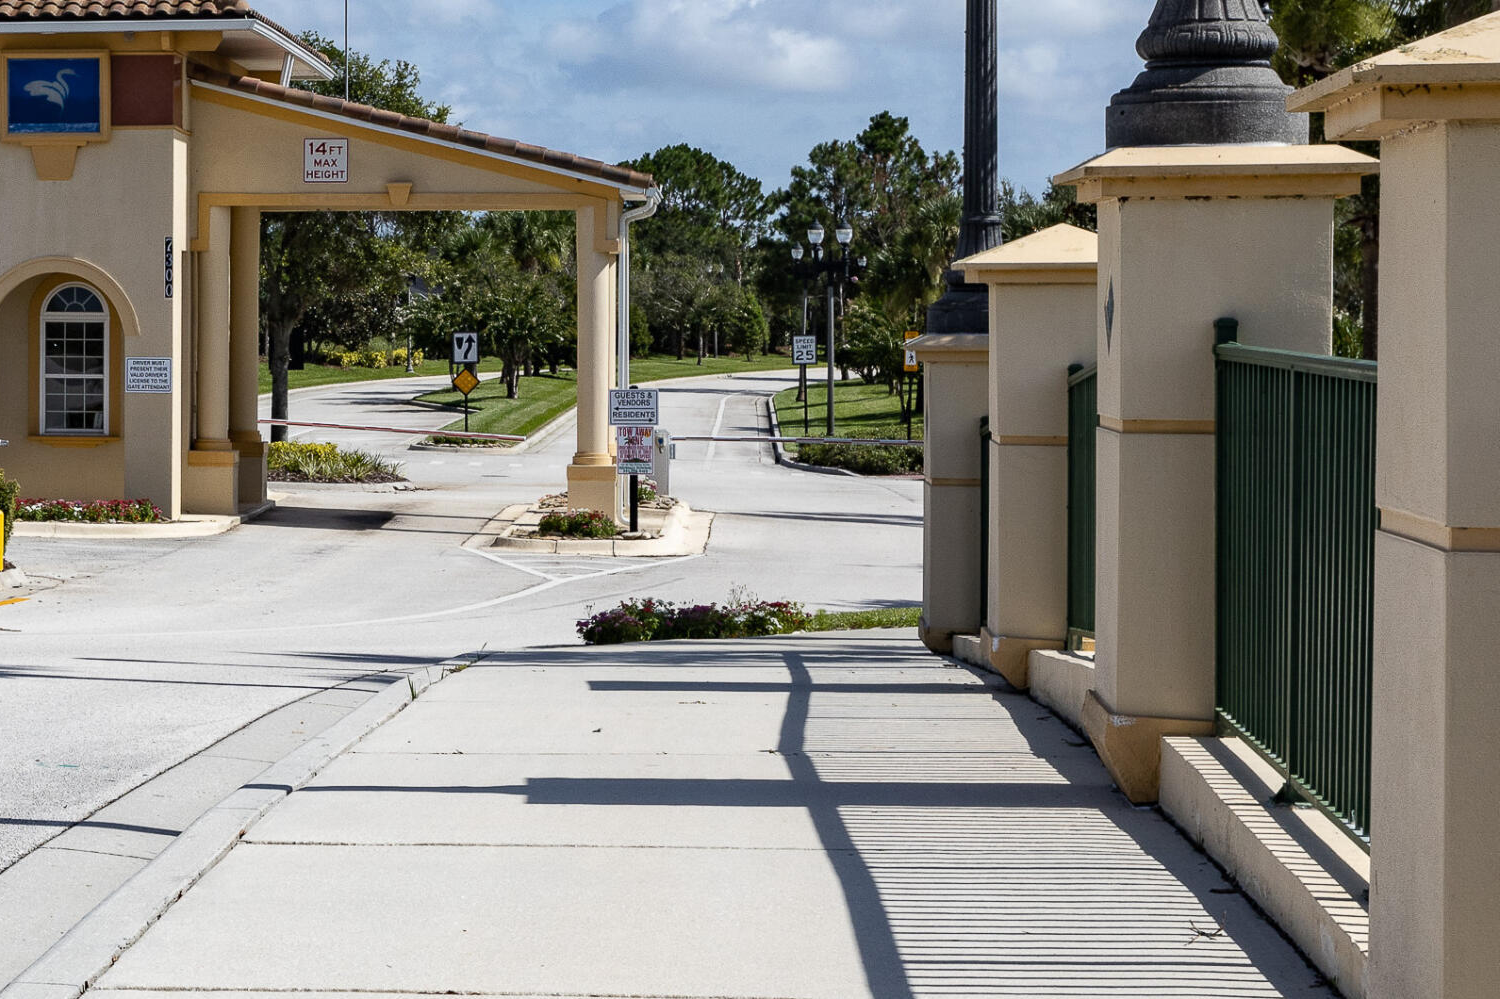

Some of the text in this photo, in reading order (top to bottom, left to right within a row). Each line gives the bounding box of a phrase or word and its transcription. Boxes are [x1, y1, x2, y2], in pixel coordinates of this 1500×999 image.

[314, 159, 338, 167] MAX
[306, 170, 346, 179] HEIGHT
[165, 238, 173, 297] 7300
[796, 350, 814, 361] 25
[612, 411, 656, 419] RESIDENTS
[619, 427, 652, 437] TOW AWAY
